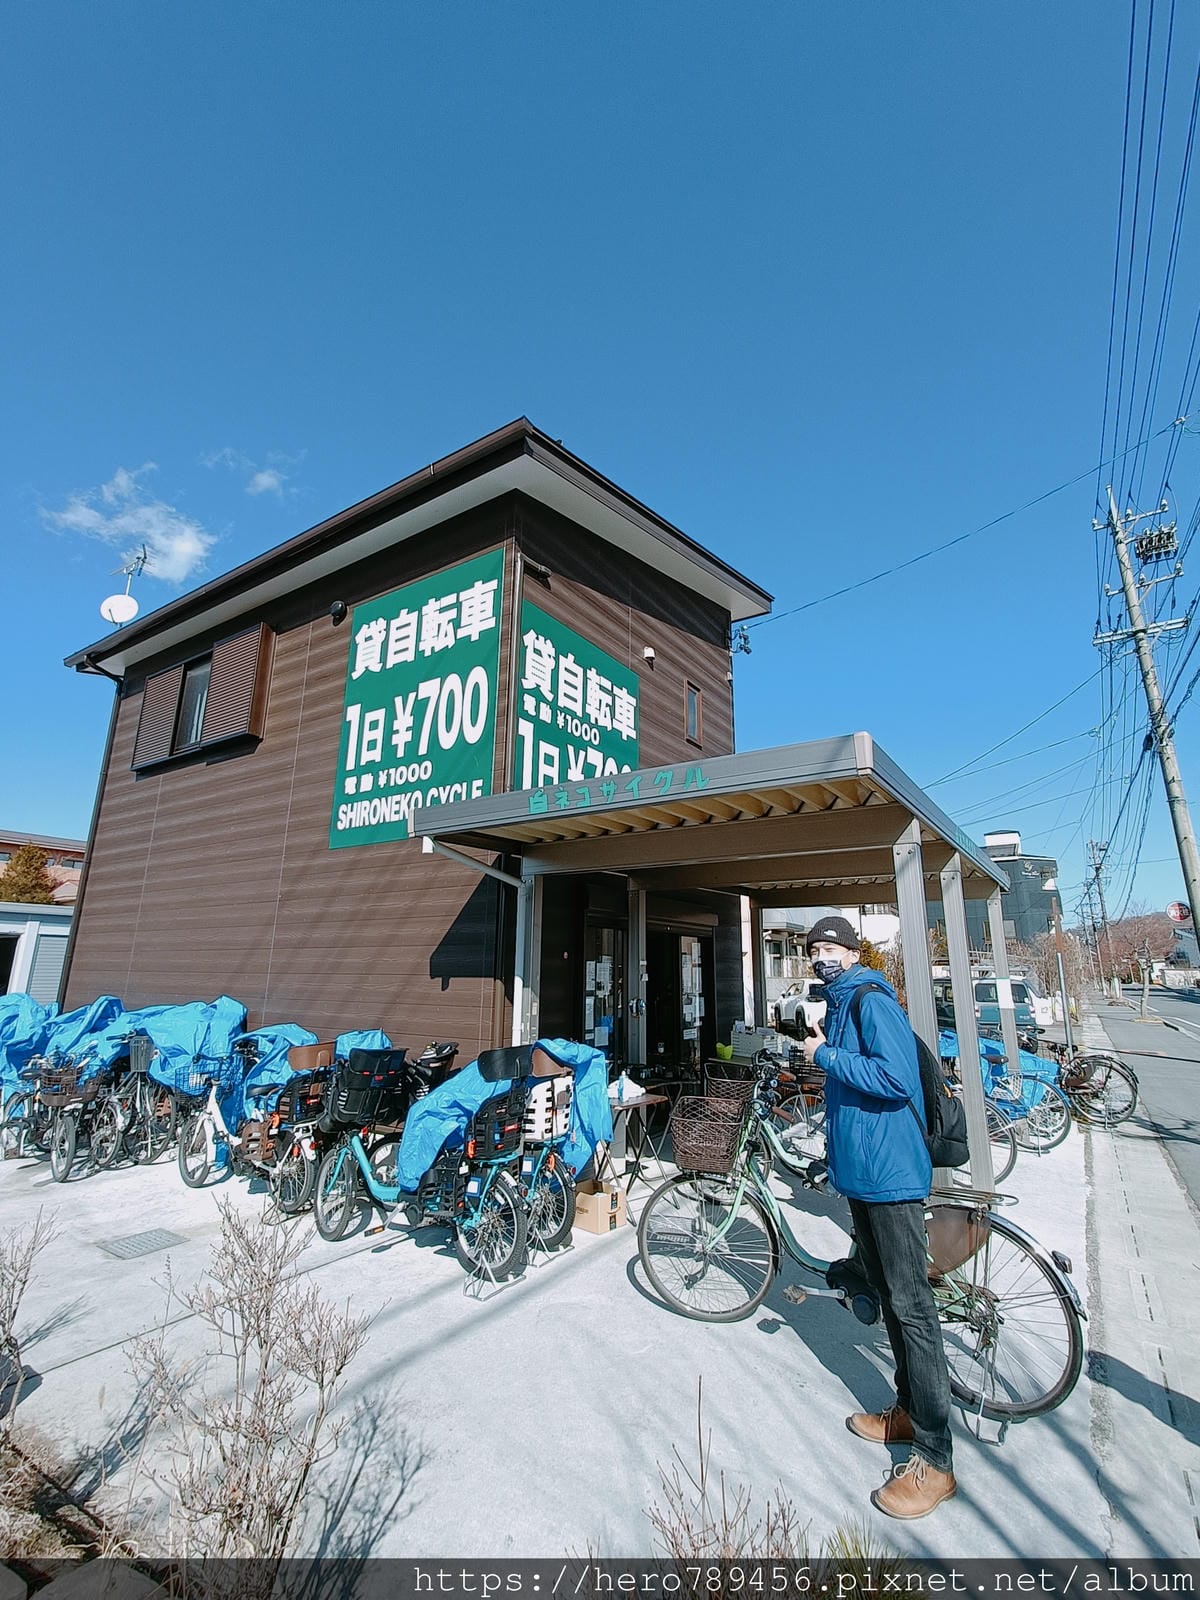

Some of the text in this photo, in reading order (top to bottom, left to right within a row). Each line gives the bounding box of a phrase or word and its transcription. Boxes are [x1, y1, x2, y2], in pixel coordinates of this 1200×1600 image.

[351, 579, 498, 680] 貸自転車
[345, 665, 489, 771] 1日 ¥700
[521, 629, 637, 741] 貸自転車
[518, 717, 560, 791] 1日
[556, 709, 600, 746] ¥1000
[378, 760, 432, 789] ¥1000
[529, 767, 710, 814] 白ネコサイクル
